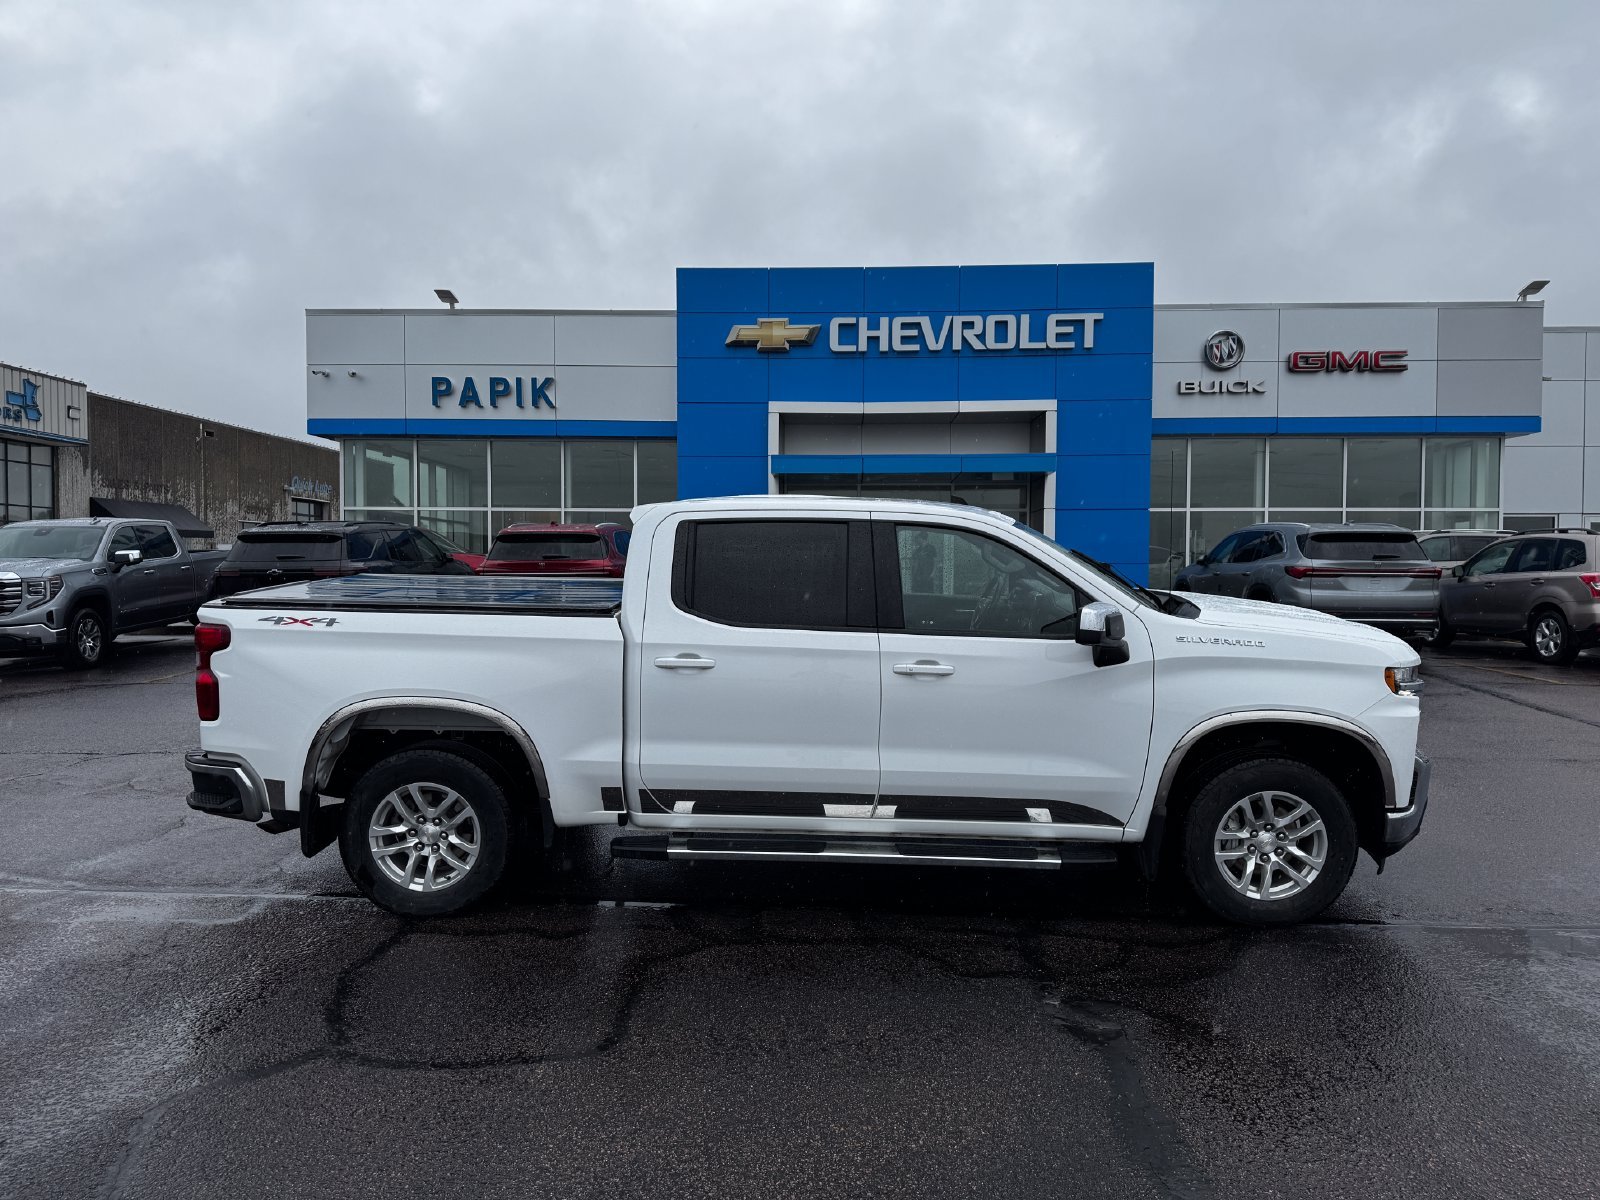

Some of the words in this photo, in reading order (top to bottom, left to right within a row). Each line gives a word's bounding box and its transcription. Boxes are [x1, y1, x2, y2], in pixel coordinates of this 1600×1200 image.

[829, 312, 1104, 352] CHEVROLET
[1289, 350, 1409, 372] GMC
[431, 376, 556, 408] PAPIK
[1178, 379, 1268, 394] BUICK
[1176, 635, 1266, 648] SILVERADO
